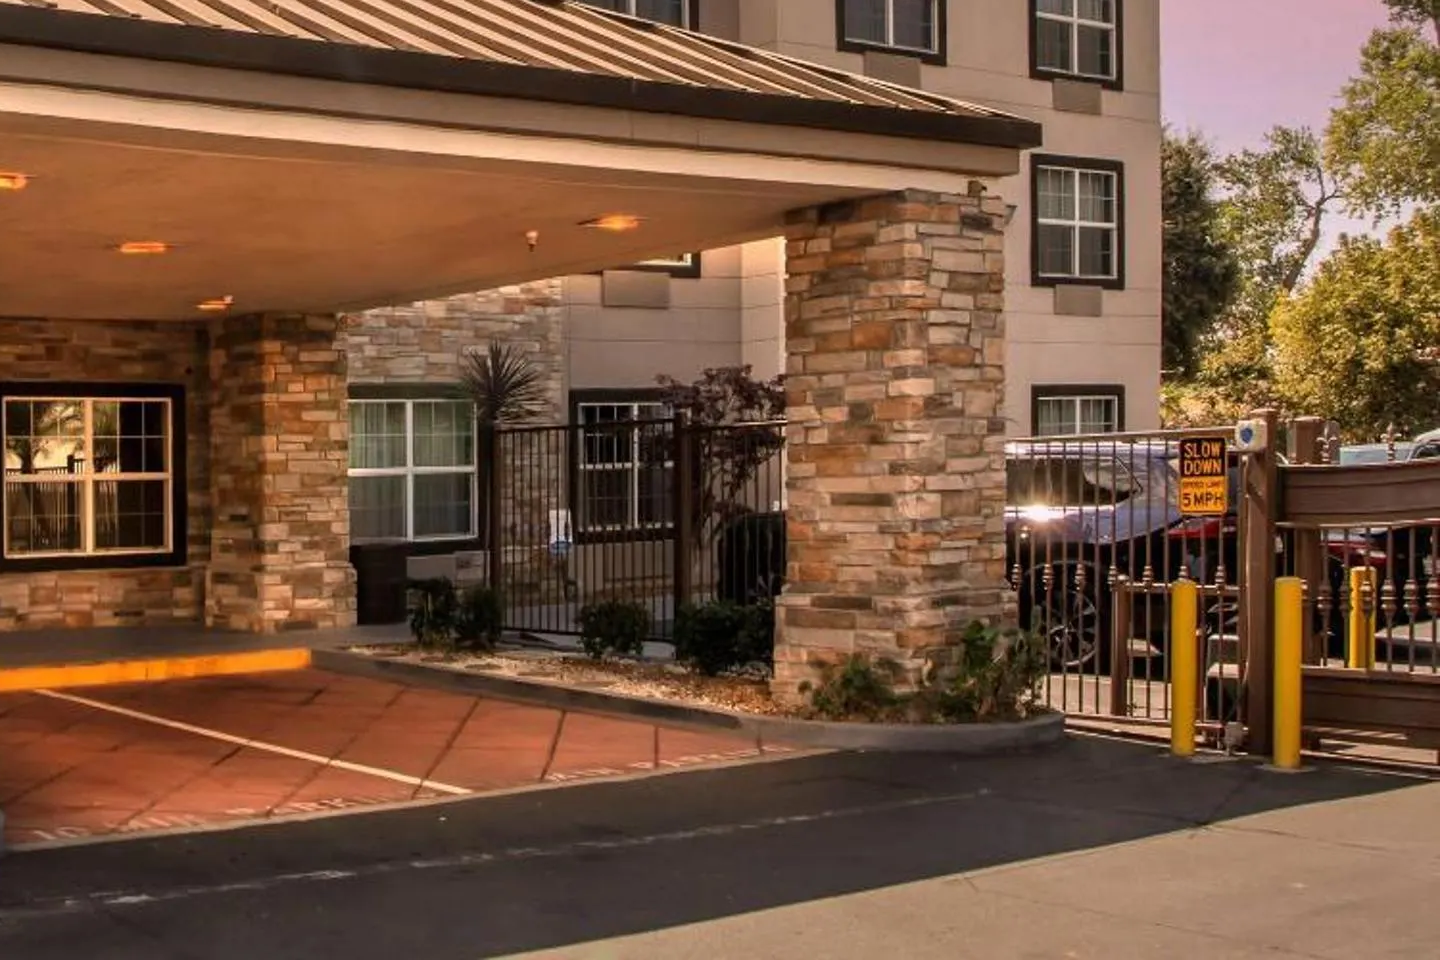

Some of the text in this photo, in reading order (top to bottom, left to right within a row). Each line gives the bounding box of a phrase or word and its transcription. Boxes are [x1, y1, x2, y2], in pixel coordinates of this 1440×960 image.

[1184, 442, 1221, 459] SLOW
[1183, 459, 1222, 476] DOWN
[1182, 491, 1225, 508] 5 MPH
